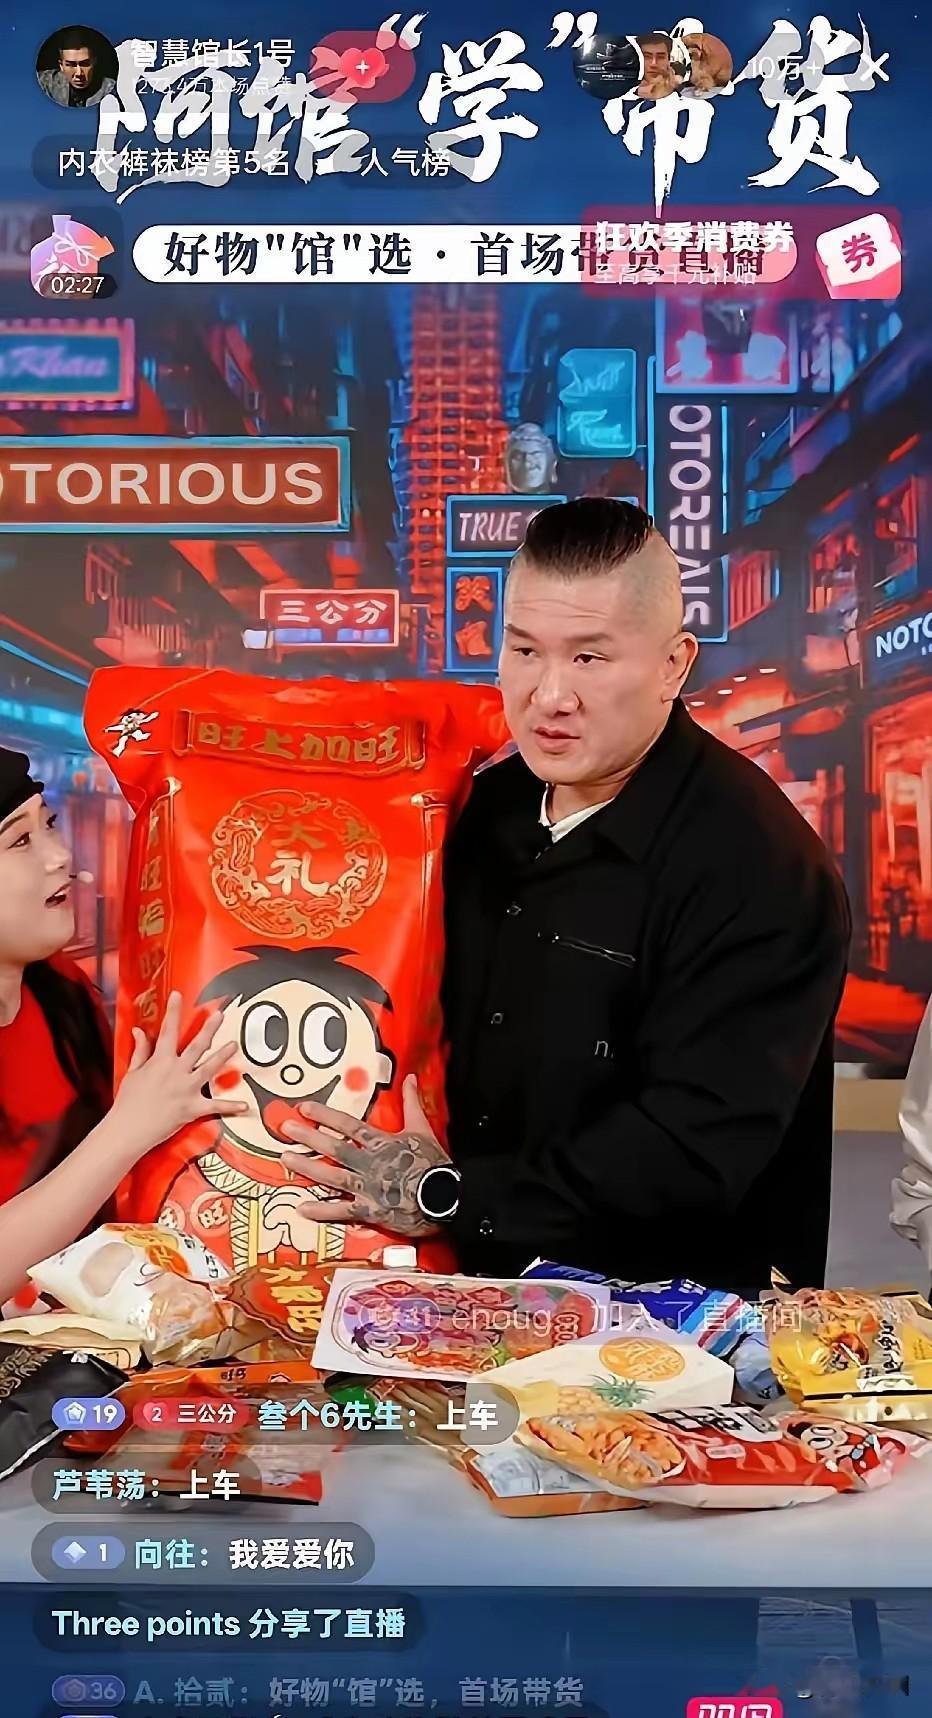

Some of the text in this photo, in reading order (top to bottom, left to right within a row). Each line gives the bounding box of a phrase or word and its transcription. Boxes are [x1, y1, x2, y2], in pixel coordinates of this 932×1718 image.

[0, 462, 324, 506] TORIOUS
[459, 511, 522, 542] TRUE
[277, 599, 388, 625] 三公分
